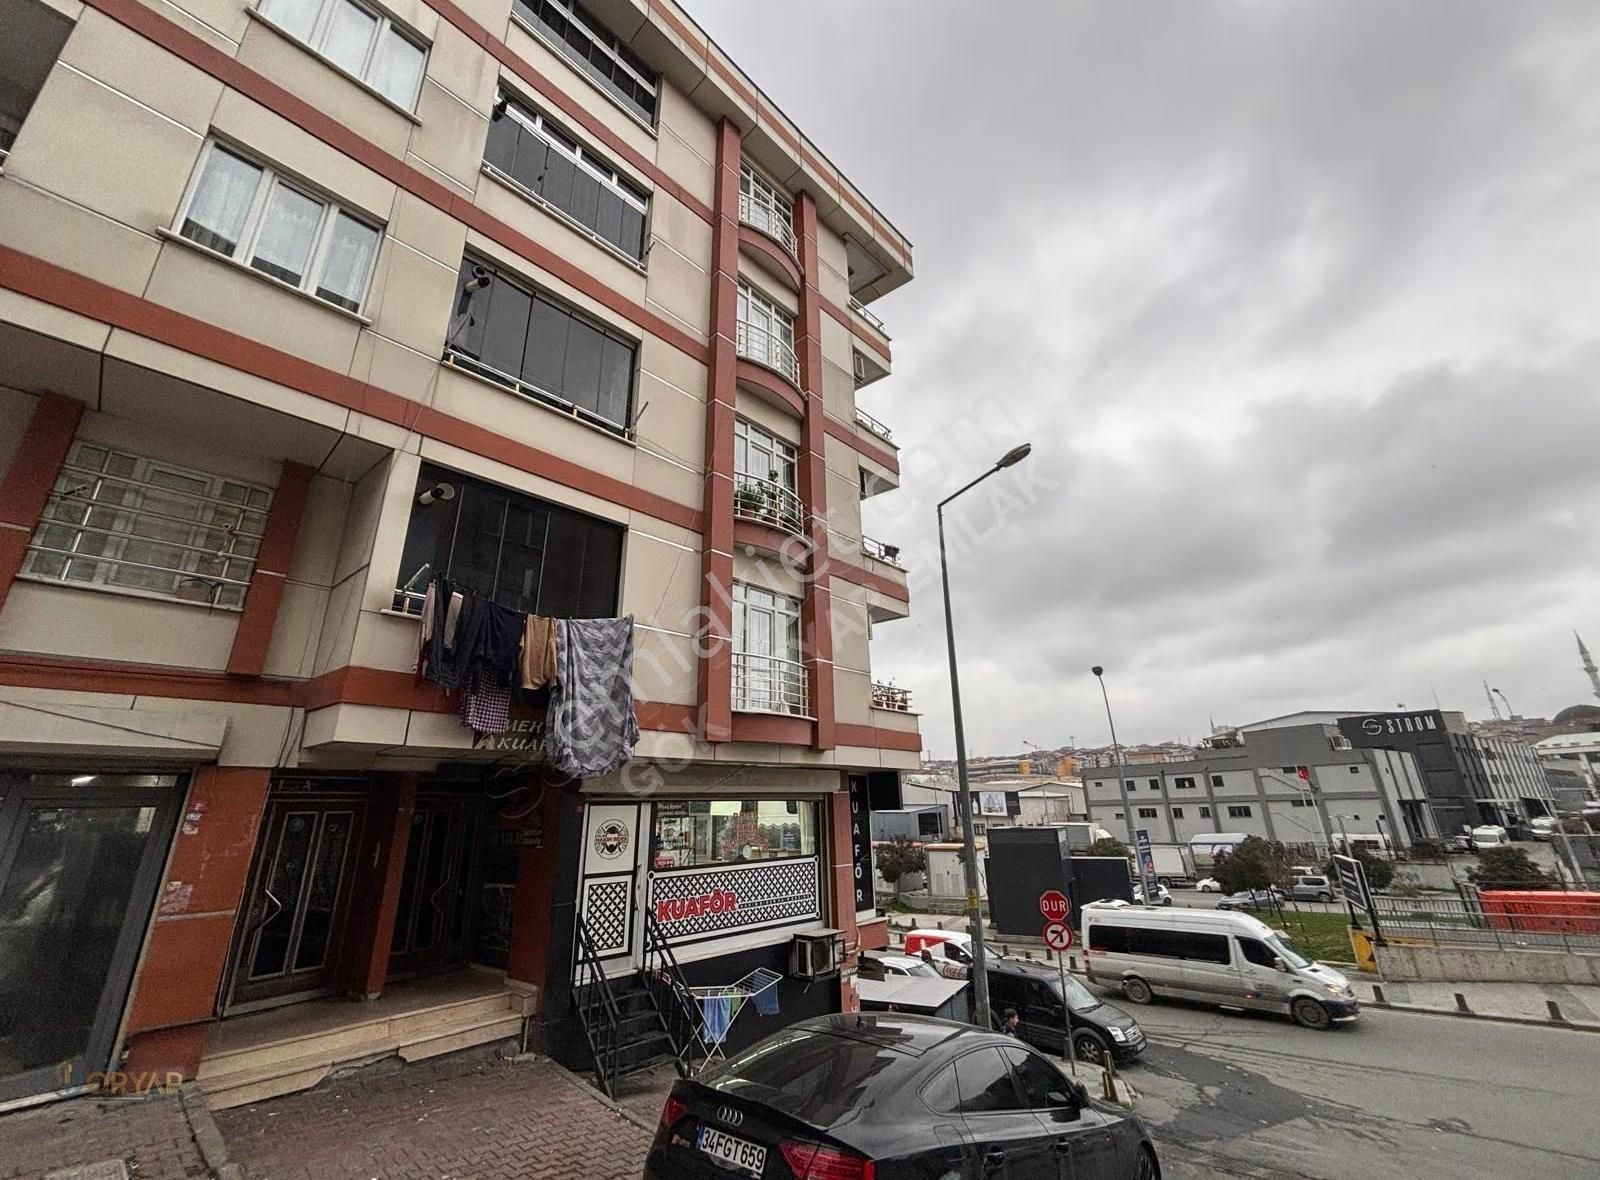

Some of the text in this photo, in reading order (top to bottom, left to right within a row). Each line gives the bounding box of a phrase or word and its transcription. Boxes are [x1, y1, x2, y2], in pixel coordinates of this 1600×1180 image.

[851, 781, 863, 902] KUAFÖR
[657, 889, 737, 922] KUAFÖR
[1042, 900, 1066, 911] DUR
[702, 1130, 764, 1170] 34FGT659
